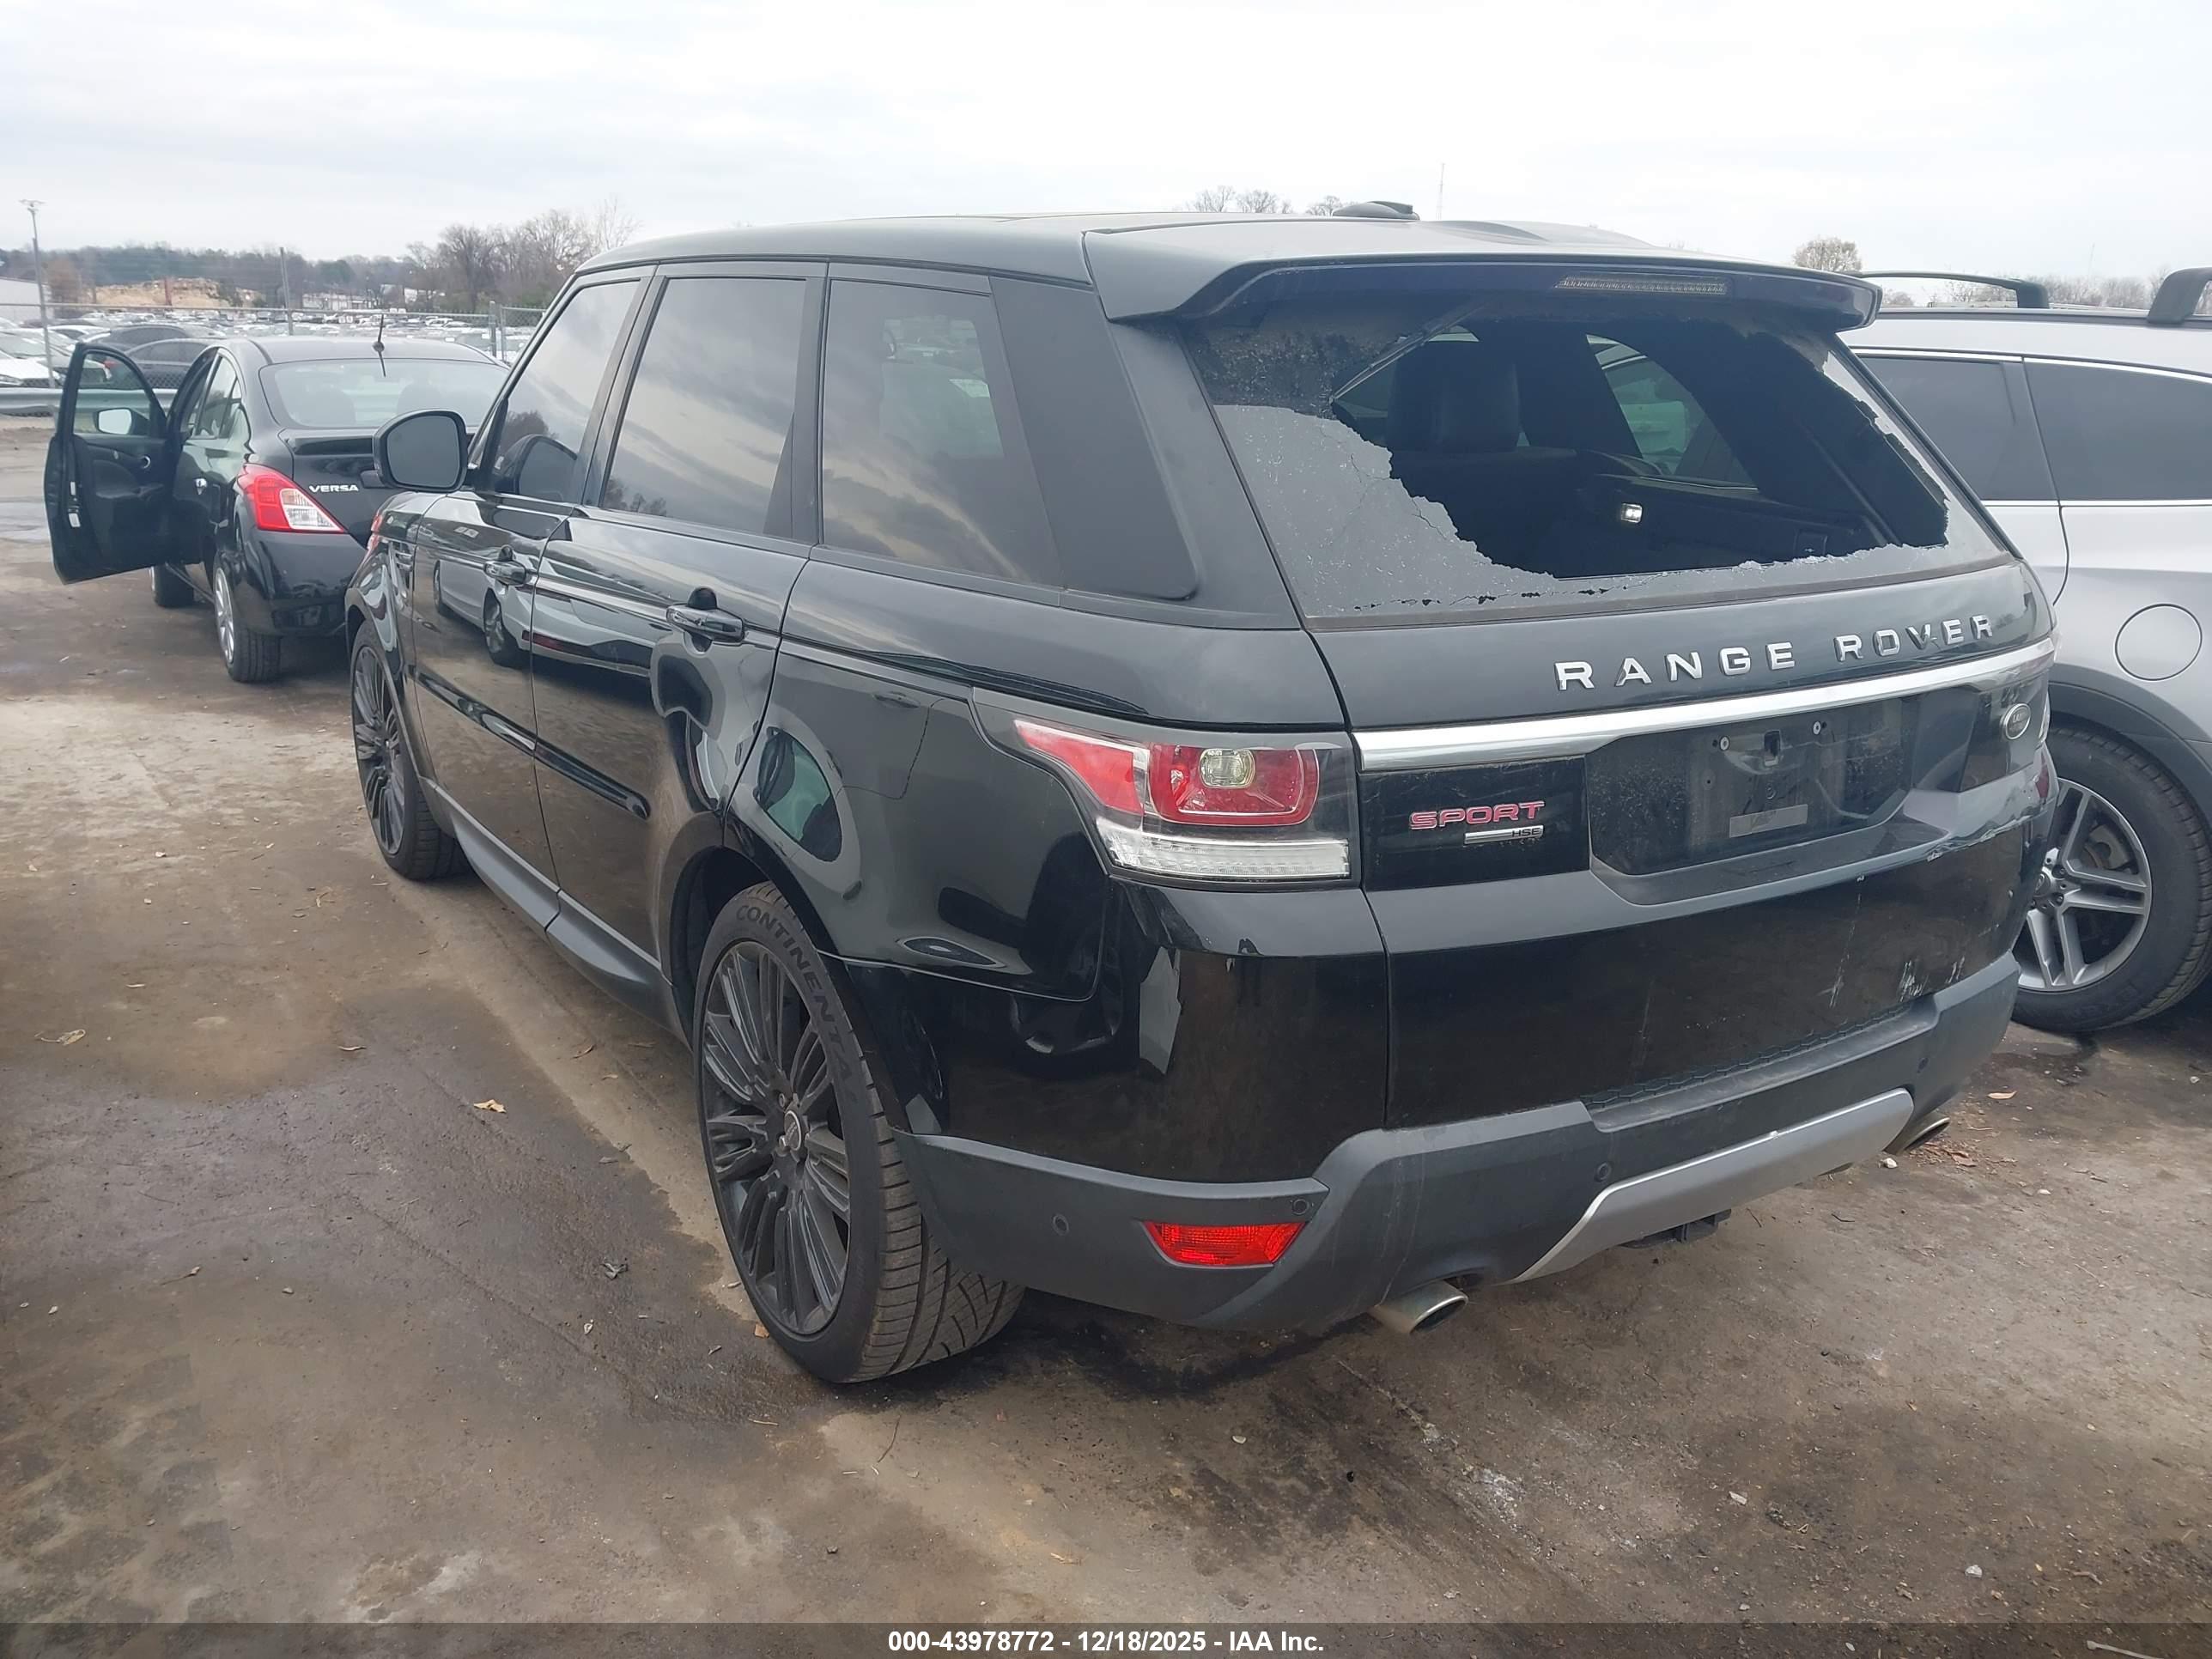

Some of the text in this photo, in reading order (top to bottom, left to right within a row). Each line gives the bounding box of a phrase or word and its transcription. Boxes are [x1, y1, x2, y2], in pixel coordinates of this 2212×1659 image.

[308, 484, 359, 493] VERSA
[1553, 614, 1994, 690] RANGE ROVER
[1410, 800, 1545, 830] SPORT
[1511, 827, 1542, 838] HSE
